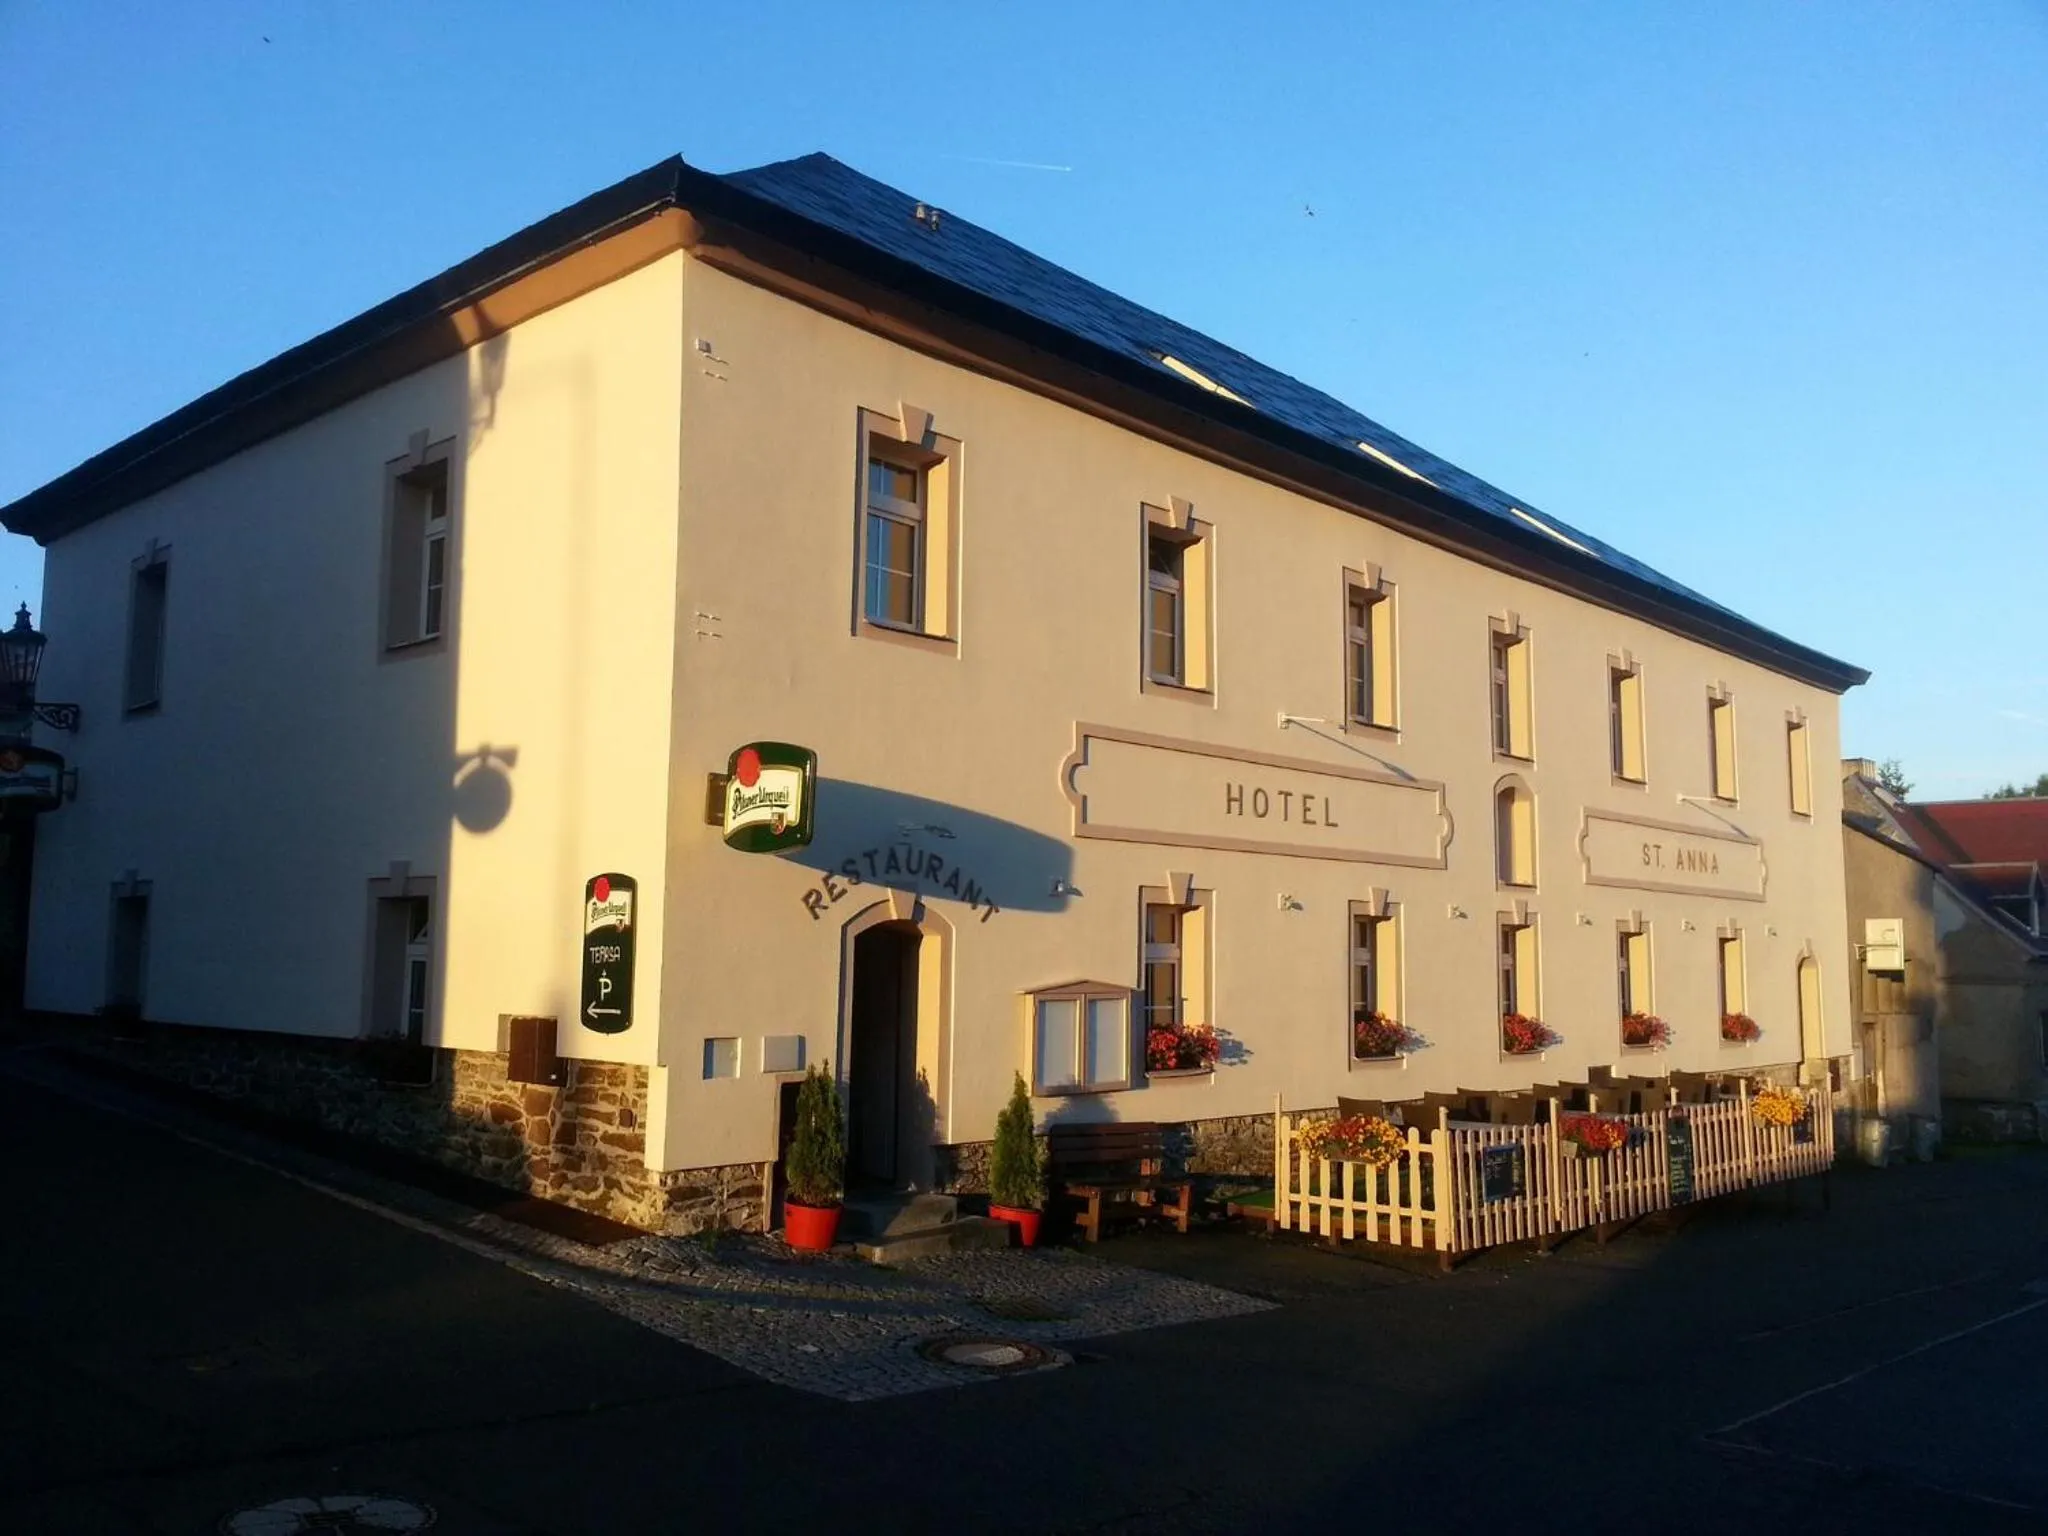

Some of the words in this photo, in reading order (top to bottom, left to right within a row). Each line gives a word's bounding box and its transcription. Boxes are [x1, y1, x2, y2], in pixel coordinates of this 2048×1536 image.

[1225, 782, 1338, 828] HOTEL
[1642, 843, 1665, 869] ST.
[1676, 848, 1719, 874] ANNA
[801, 844, 1001, 923] RESTAURANT
[598, 977, 612, 1002] P
